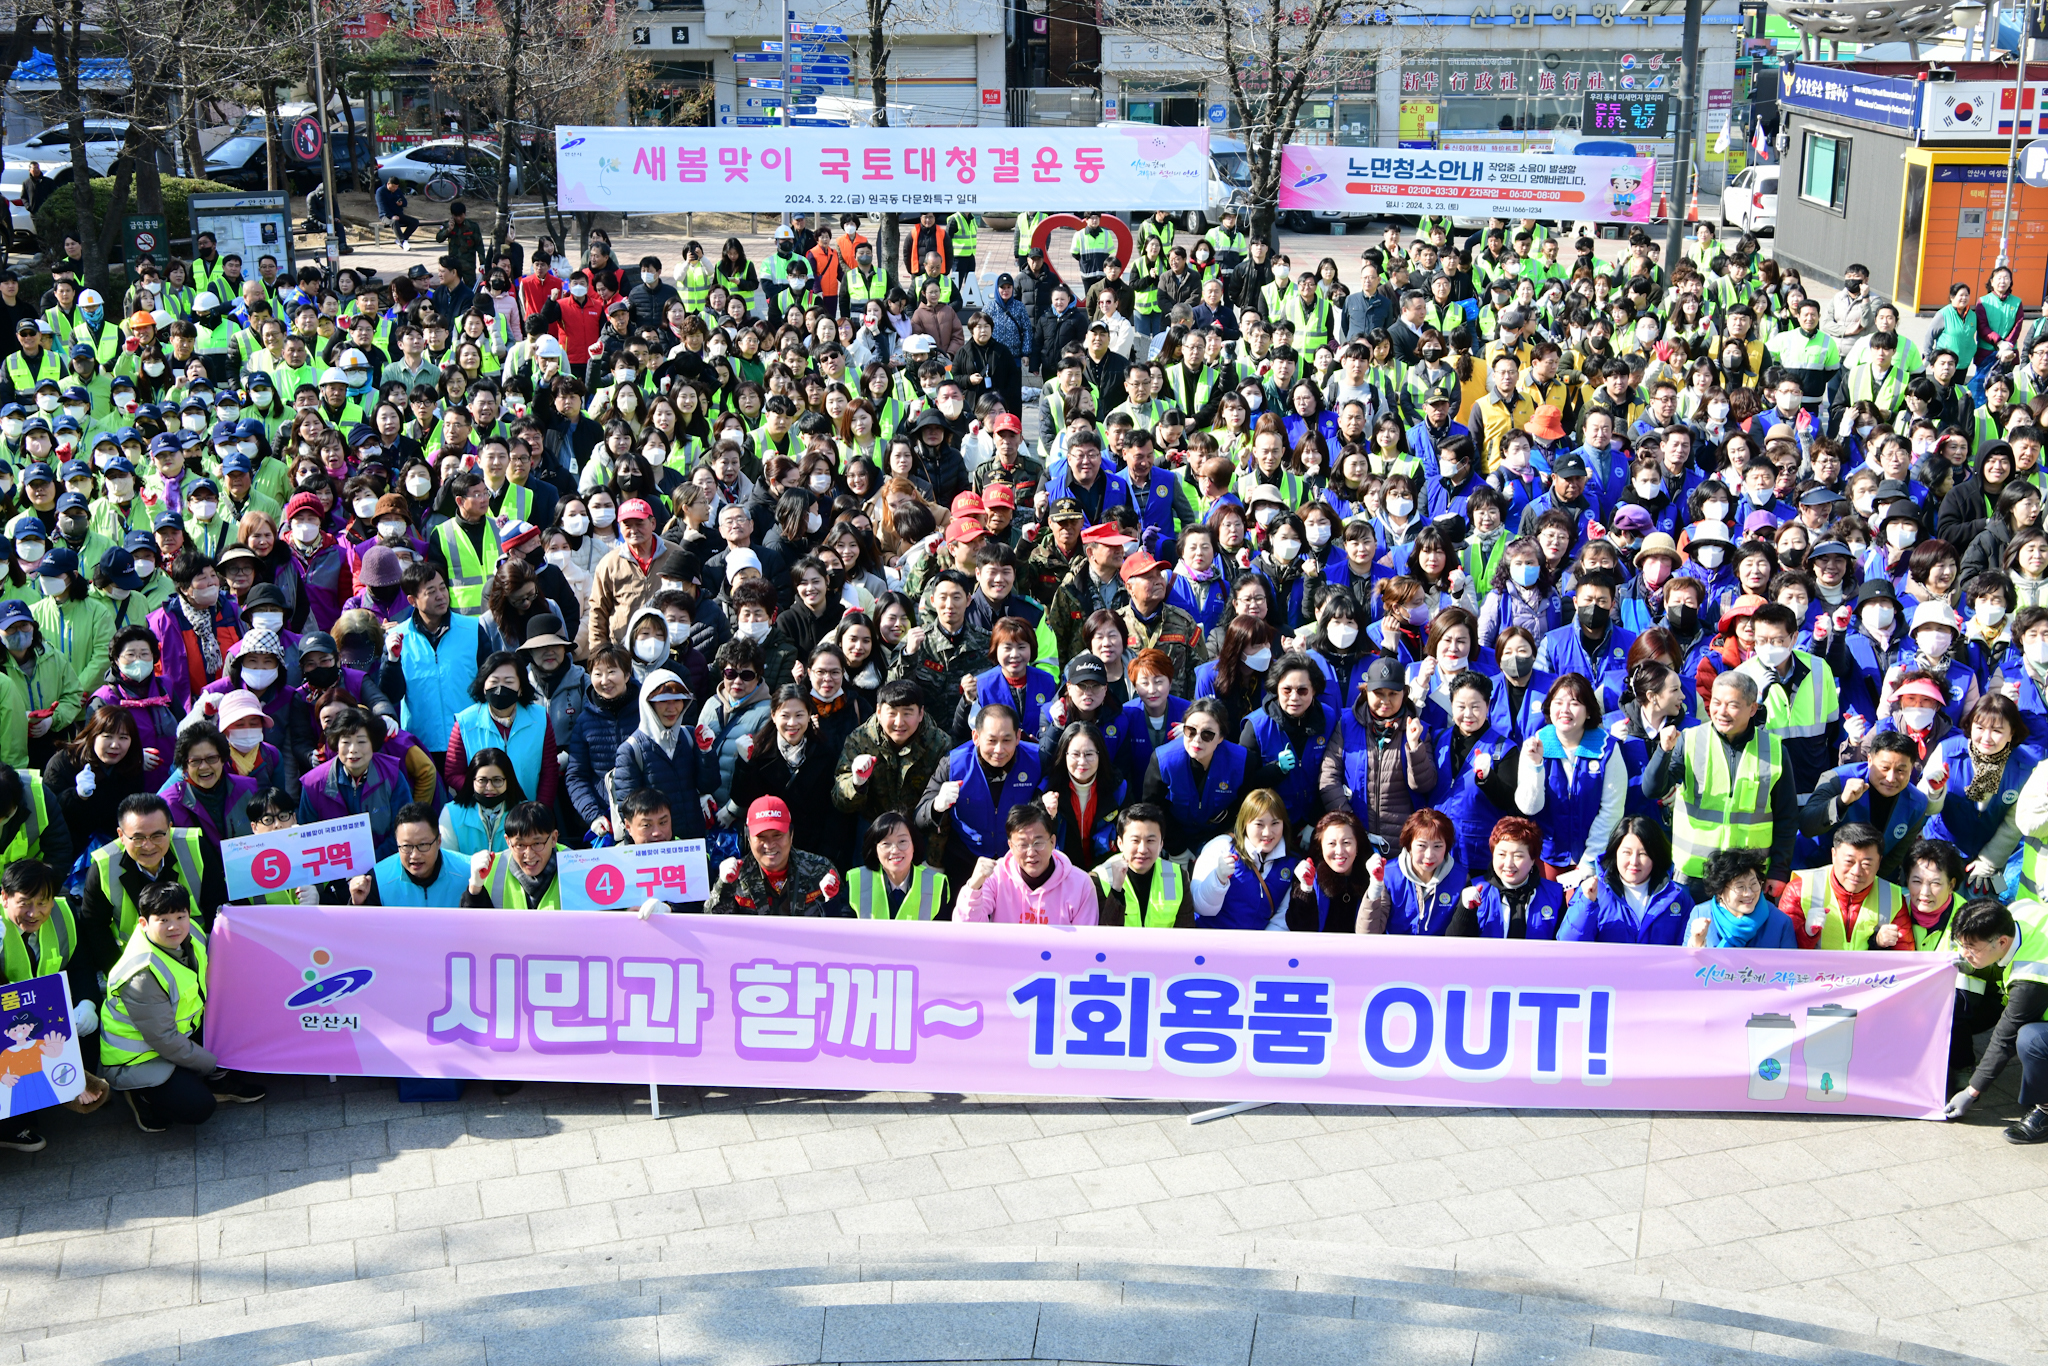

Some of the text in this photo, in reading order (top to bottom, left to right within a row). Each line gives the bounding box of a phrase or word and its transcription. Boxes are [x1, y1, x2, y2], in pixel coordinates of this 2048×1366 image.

[1403, 71, 1606, 91] 新华 行政社 旅行社
[1589, 93, 1603, 101] 우리
[1604, 93, 1617, 101] 동네
[1644, 94, 1664, 102] 알리미
[1595, 103, 1656, 116] 온도 습도
[1452, 144, 1486, 152] 신화여행사
[633, 145, 1105, 184] 새봄맞이 국토대청결운동
[1347, 157, 1483, 182] 노면청소안내
[1488, 162, 1577, 174] 작업중 소음이 발생할
[1487, 173, 1587, 186] 수 있으니 양해바랍니다.
[1967, 170, 1987, 178] 안산시
[1370, 184, 1398, 194] 1차작업
[1408, 186, 1459, 196] 02:00~03:30
[1469, 188, 1499, 198] 2차작업
[1509, 190, 1561, 200] 06:00~08:00
[785, 194, 977, 205] 2024. 3. 22.(금) 원곡동 다문화특구 일대
[1385, 200, 1400, 208] 일시
[1406, 201, 1424, 209] 2024.
[1448, 203, 1459, 211] (토)
[1512, 206, 1542, 214] 1666-1234
[755, 809, 782, 819] ROKMC
[263, 841, 354, 881] 5 구역
[595, 865, 687, 897] 4 구역
[1694, 964, 1737, 988] 시민과
[1865, 974, 1901, 989] 안산
[301, 1013, 359, 1030] 안산시
[430, 954, 711, 1052] 시민과
[1010, 973, 1335, 1064] 1회용품
[1362, 985, 1612, 1079] OUT!
